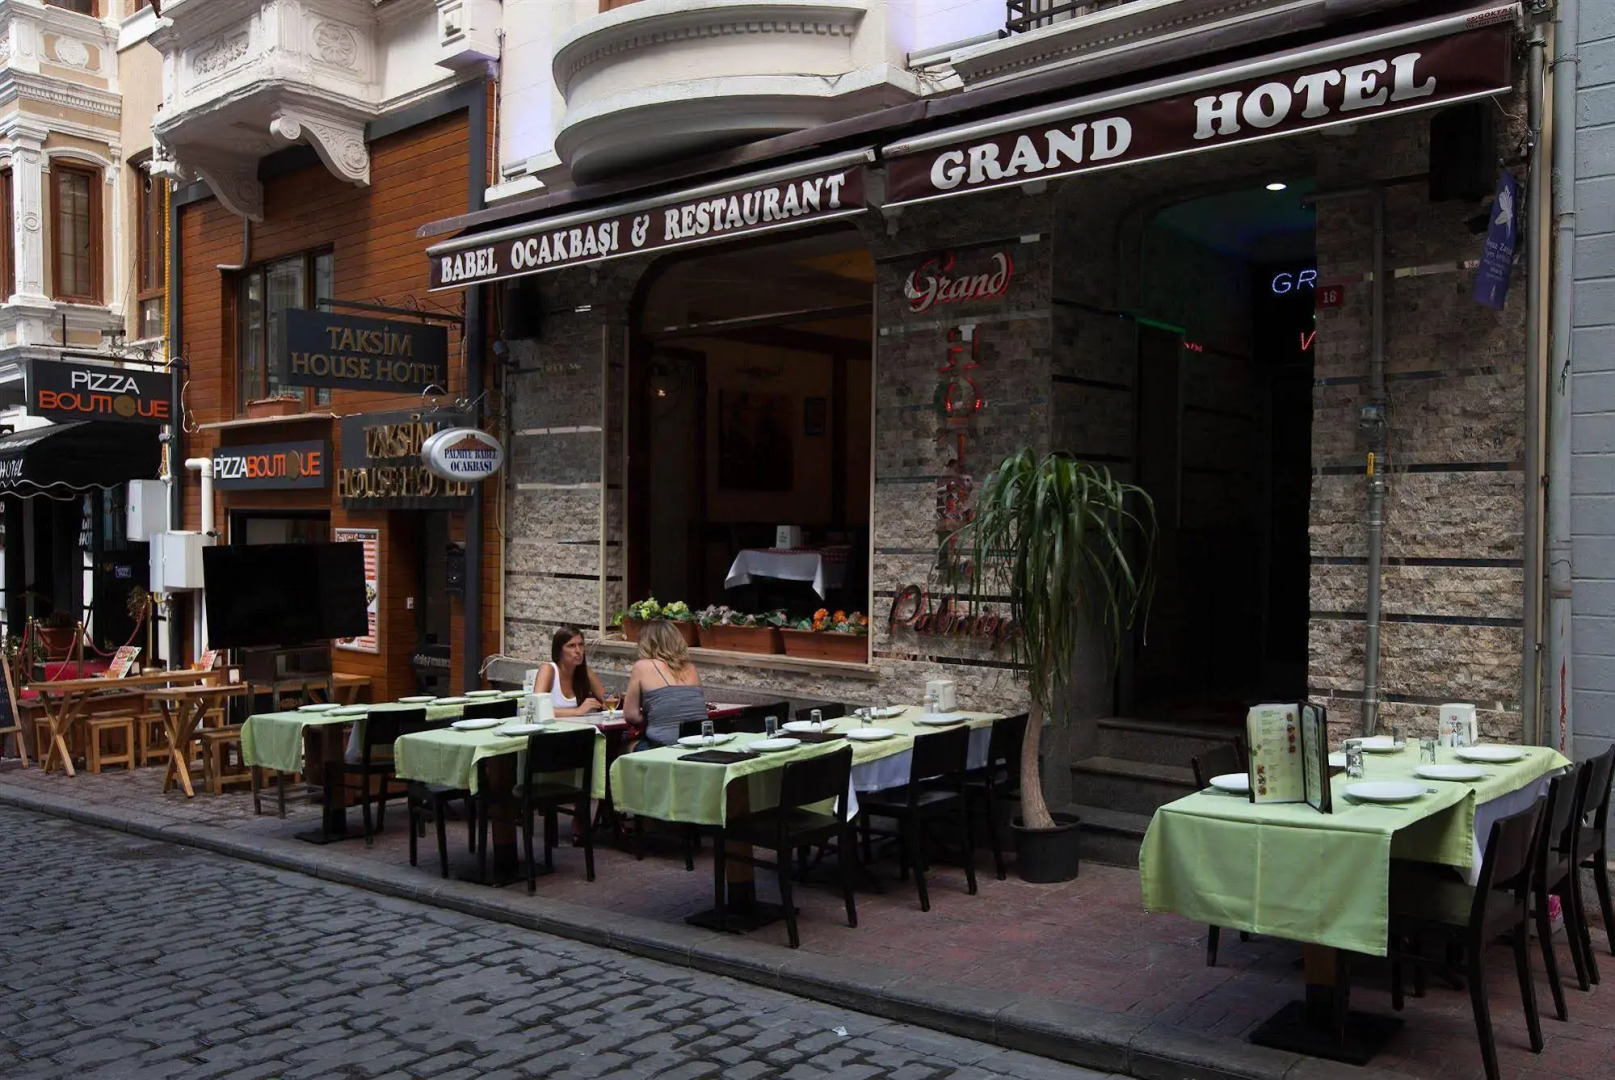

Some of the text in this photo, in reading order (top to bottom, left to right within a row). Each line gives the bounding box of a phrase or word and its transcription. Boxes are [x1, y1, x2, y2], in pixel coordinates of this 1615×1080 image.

[929, 52, 1437, 190] GRAND HOTEL
[440, 173, 846, 284] BABEL OCAKBAŞI & RESTAURANT
[904, 251, 1014, 314] Grand
[1323, 290, 1337, 304] 16
[291, 351, 446, 386] HOUSE HOTEL
